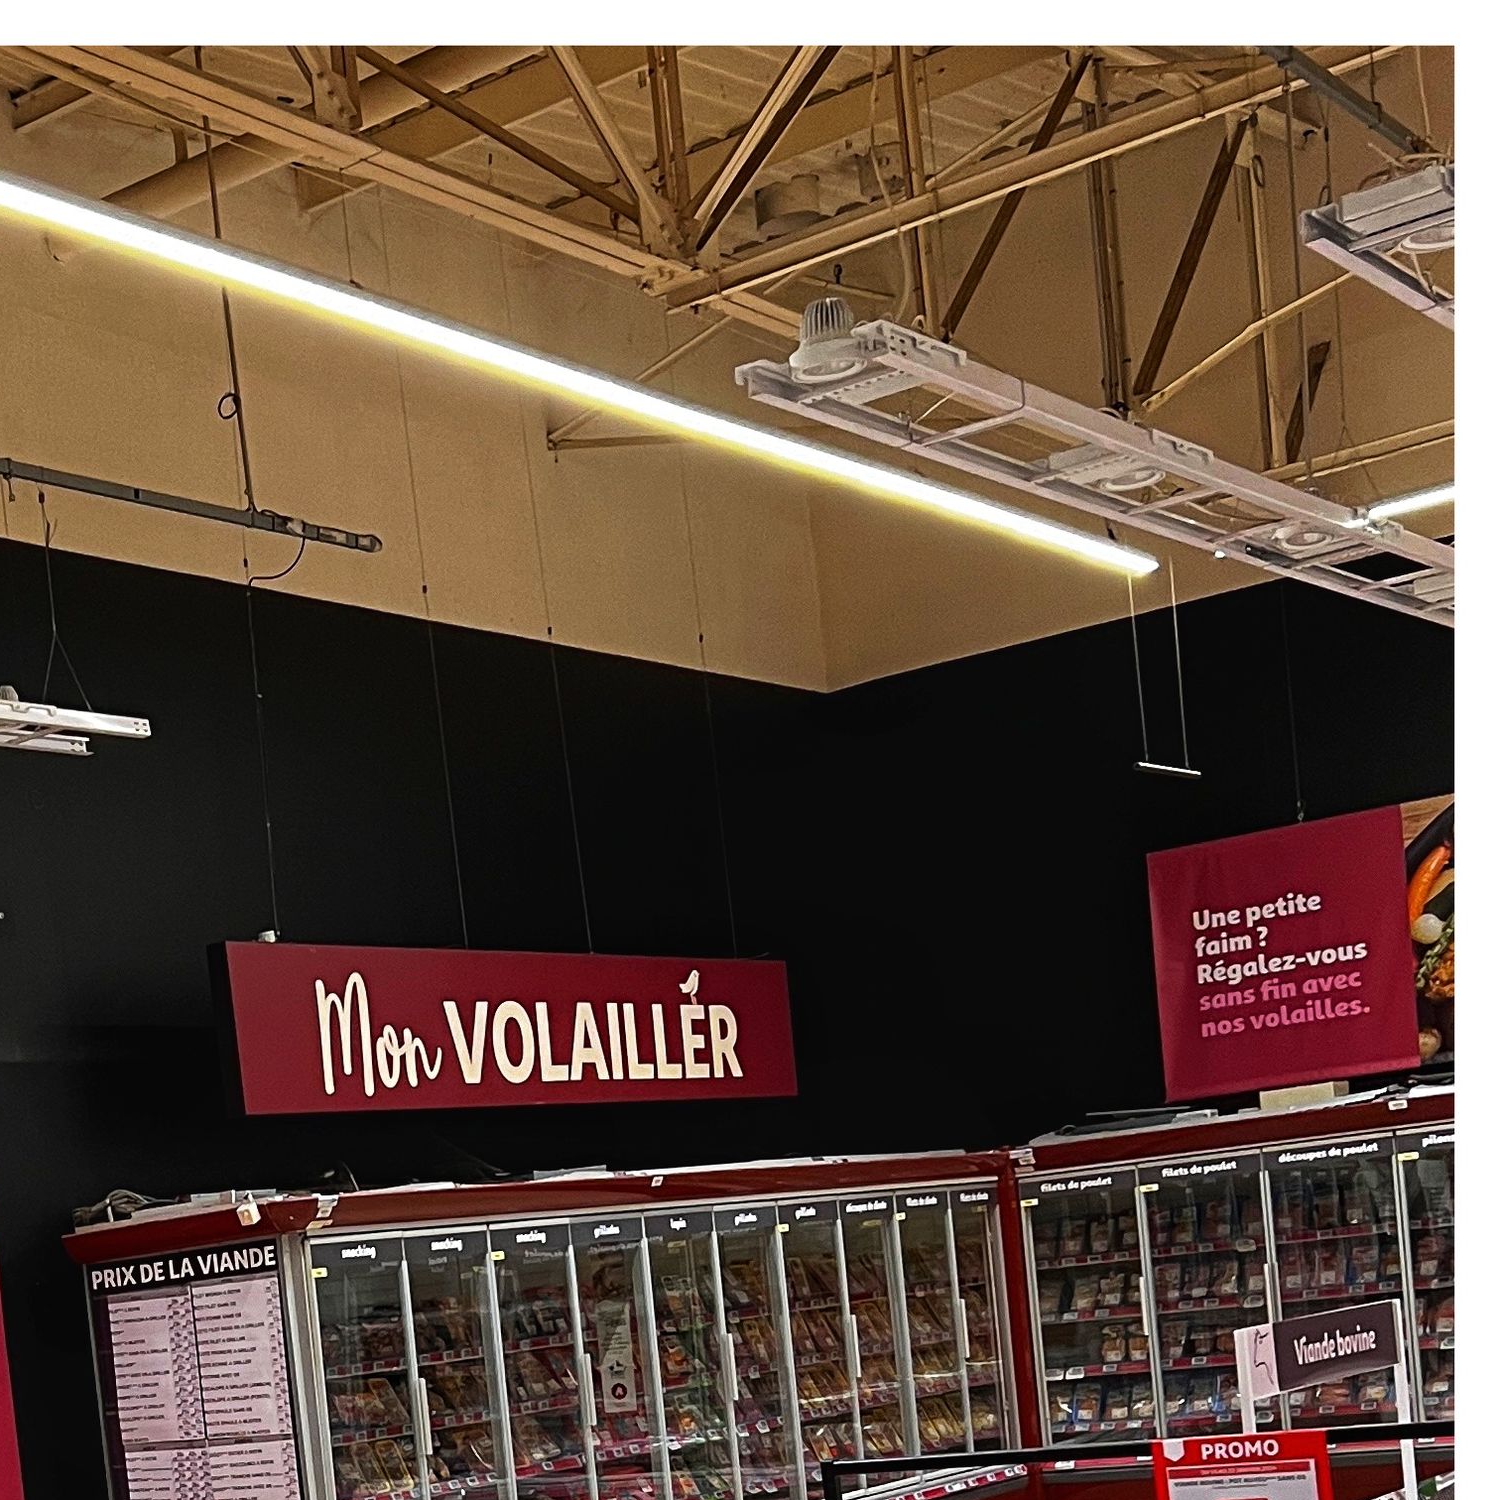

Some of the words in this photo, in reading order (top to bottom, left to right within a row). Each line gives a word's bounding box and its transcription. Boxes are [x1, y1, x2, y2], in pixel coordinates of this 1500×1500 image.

[1192, 908, 1240, 930] Une
[1246, 893, 1321, 928] petite
[1195, 932, 1252, 957] faim
[1257, 926, 1268, 947] ?
[1197, 942, 1368, 985] Régalez-vous
[1200, 987, 1255, 1011] sans
[1260, 979, 1296, 1002] fin
[1303, 971, 1362, 994] avec
[315, 971, 442, 1097] Mon
[443, 1000, 744, 1084] VOLAILLER
[1201, 1017, 1244, 1037] nos
[1250, 999, 1370, 1030] volailles.
[92, 1265, 137, 1290] PRIX
[140, 1262, 165, 1284] DE
[169, 1257, 194, 1280] LA
[197, 1245, 276, 1275] VIANDE
[1294, 1330, 1336, 1366] Viande
[1337, 1325, 1376, 1356] bovine
[1201, 1439, 1279, 1460] PROMO
